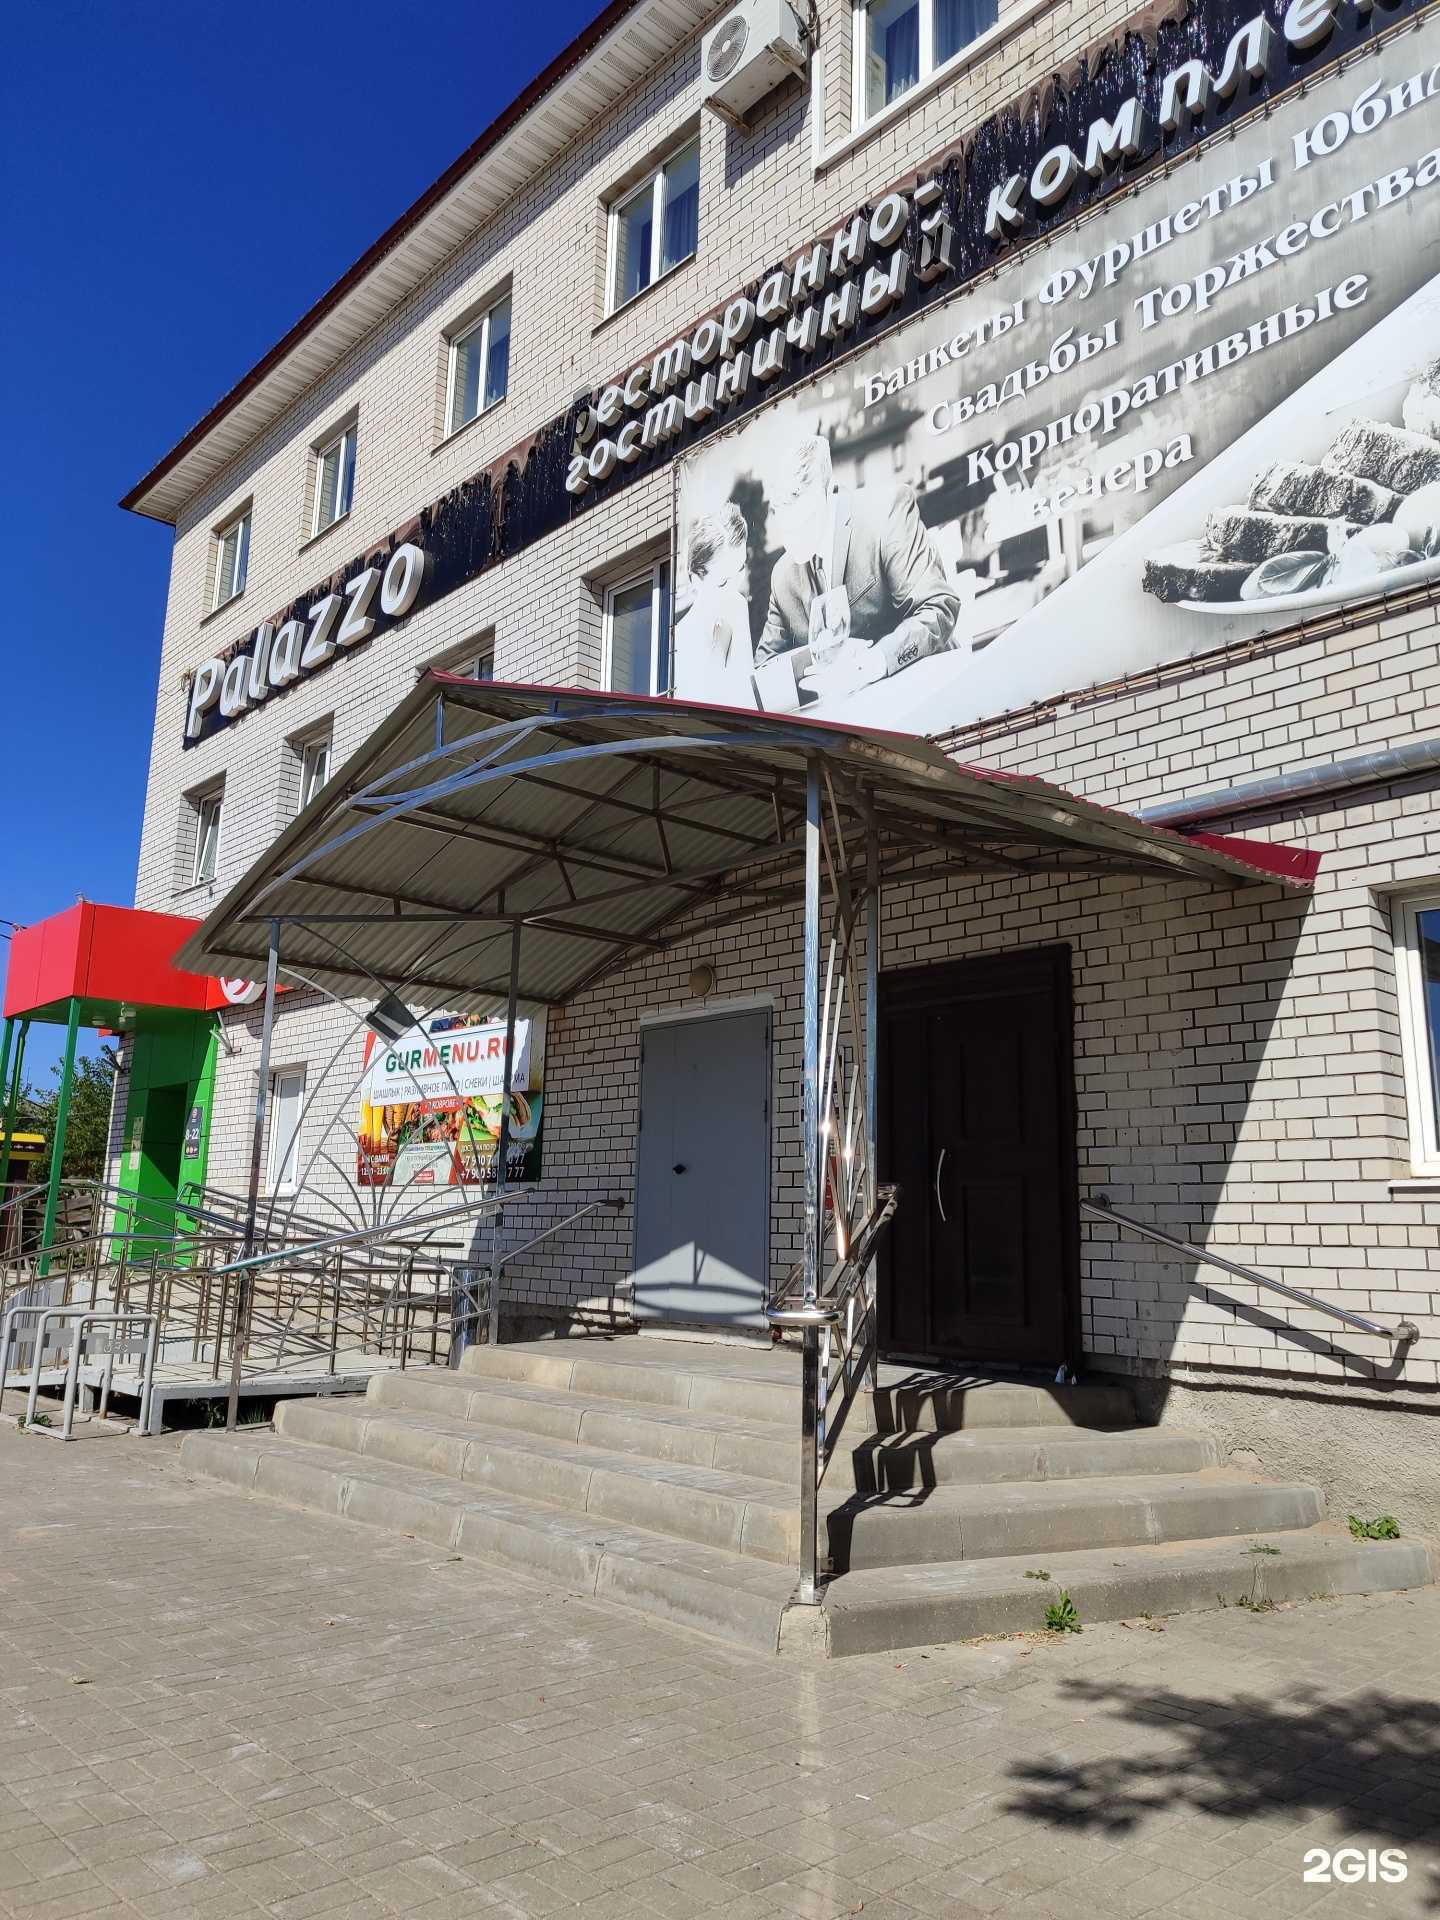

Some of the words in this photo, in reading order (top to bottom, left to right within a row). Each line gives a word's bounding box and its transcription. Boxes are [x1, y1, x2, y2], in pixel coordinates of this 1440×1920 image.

[984, 0, 1374, 240] компле
[863, 299, 1026, 409] Банкеты
[1037, 157, 1274, 306] Фуршеты
[928, 319, 1119, 436] Свадьбы
[1134, 148, 1440, 332] Торжества
[967, 273, 1369, 486] Корпоративные
[1033, 432, 1195, 520] вечера
[187, 543, 424, 738] Palazzo
